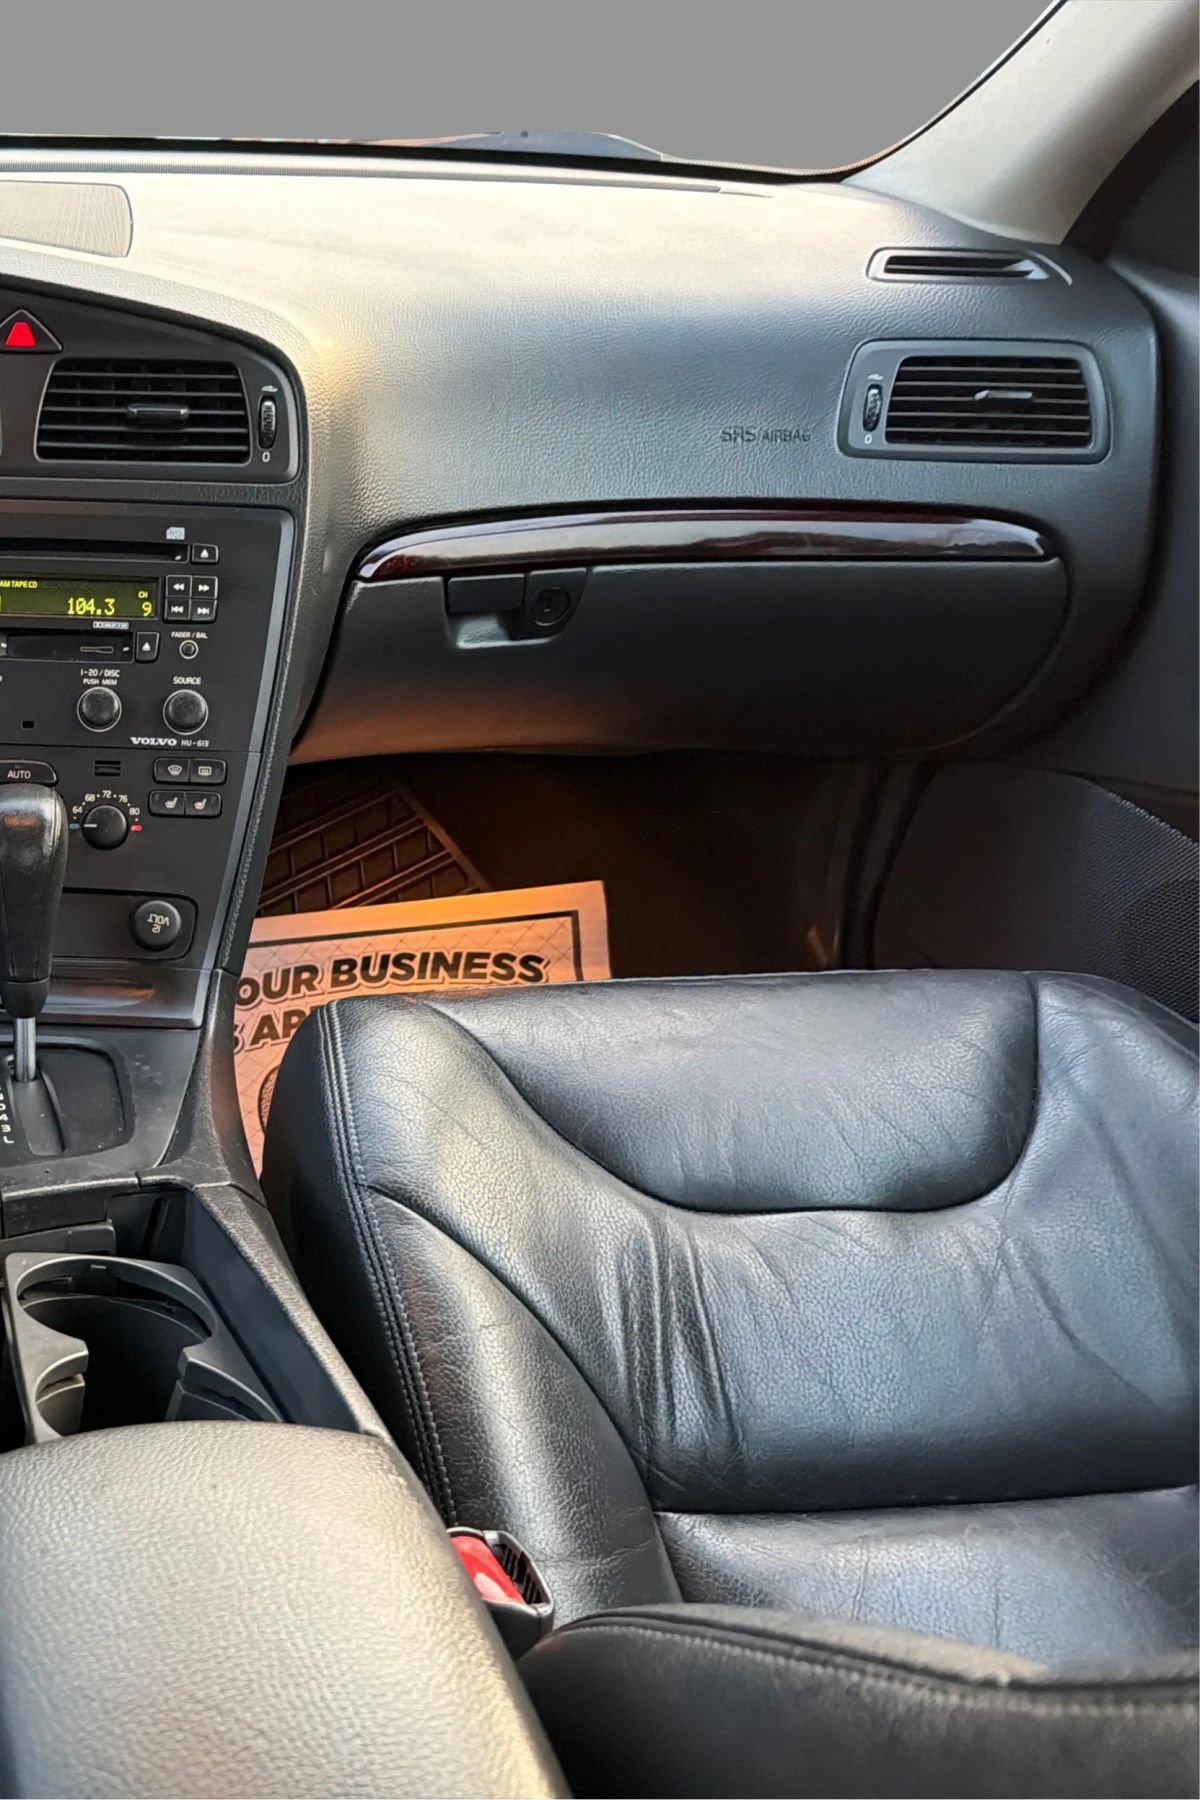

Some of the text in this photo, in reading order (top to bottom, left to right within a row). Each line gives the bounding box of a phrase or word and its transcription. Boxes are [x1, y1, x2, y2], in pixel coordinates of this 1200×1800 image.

[720, 426, 811, 443] SRS AIRBAG
[138, 591, 149, 599] CH
[67, 597, 116, 616] 104.3
[142, 602, 153, 617] 9
[104, 669, 120, 678] DISC
[101, 678, 118, 686] MEM
[173, 677, 201, 685] SOURCE
[130, 737, 177, 746] VOLVO
[7, 770, 31, 779] AUTO
[85, 794, 96, 802] 68
[102, 790, 112, 799] 72
[118, 795, 128, 803] 76
[72, 806, 83, 814] 64
[129, 807, 140, 815] 80
[147, 913, 170, 926] VOLT
[235, 951, 545, 1006] OUR BUSINESS
[0, 1124, 11, 1132] 3
[3, 1135, 15, 1144] L
